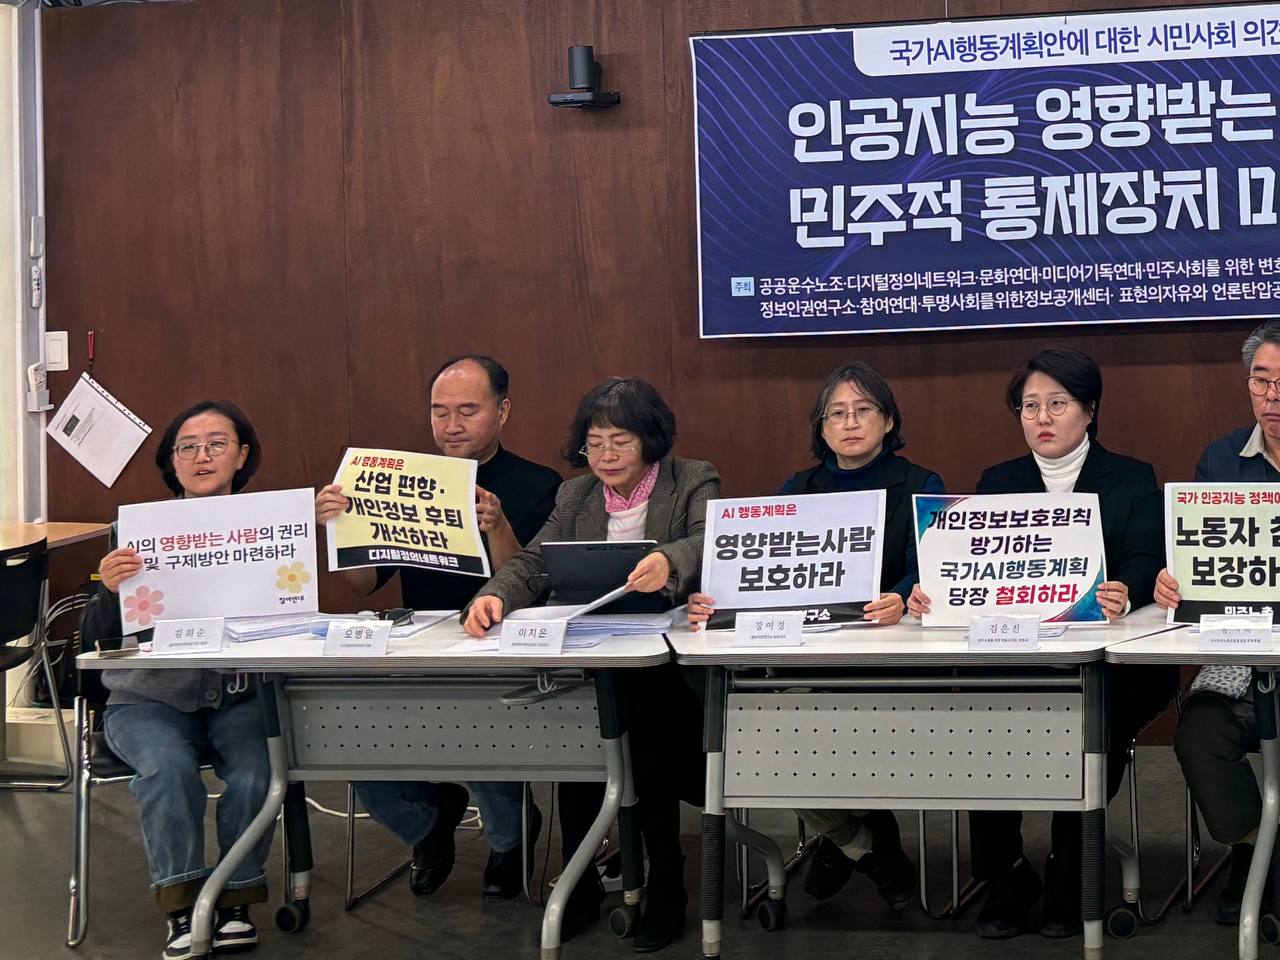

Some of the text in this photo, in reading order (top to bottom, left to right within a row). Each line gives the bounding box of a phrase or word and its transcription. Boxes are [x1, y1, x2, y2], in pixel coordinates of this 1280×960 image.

[889, 26, 1089, 65] 국가AI행동계획안에
[1095, 25, 1141, 54] 대한
[1147, 18, 1238, 51] 시민사회
[788, 92, 1019, 163] 인공지능
[1035, 79, 1277, 152] 영향받는
[788, 178, 962, 248] 민주적
[980, 166, 1220, 241] 통제장치
[1224, 257, 1255, 276] 위한
[1119, 283, 1208, 304] 표현의자유와
[351, 456, 362, 466] AI
[354, 470, 392, 495] 산업
[1177, 491, 1198, 505] 국가
[1201, 491, 1246, 505] 인공지능
[345, 496, 464, 529] 개인정보 후퇴
[721, 502, 798, 520] AI 행동계획은
[927, 507, 1092, 531] 개인정보보호원칙
[160, 530, 225, 552] 영향받는
[227, 526, 274, 545] 사람의
[277, 521, 309, 541] 권리
[370, 521, 448, 549] 개선하라
[714, 525, 876, 561] 영향받는사람
[1176, 516, 1261, 548] 노동자
[143, 543, 296, 571] 및 구제방안 마련하라
[970, 534, 1053, 556] 방기하는
[368, 549, 460, 568] 디지털정의네트워크
[940, 556, 1089, 581] 국가AI행동계획
[737, 560, 846, 592] 보호하라
[949, 583, 1079, 606] 당장 철회하라
